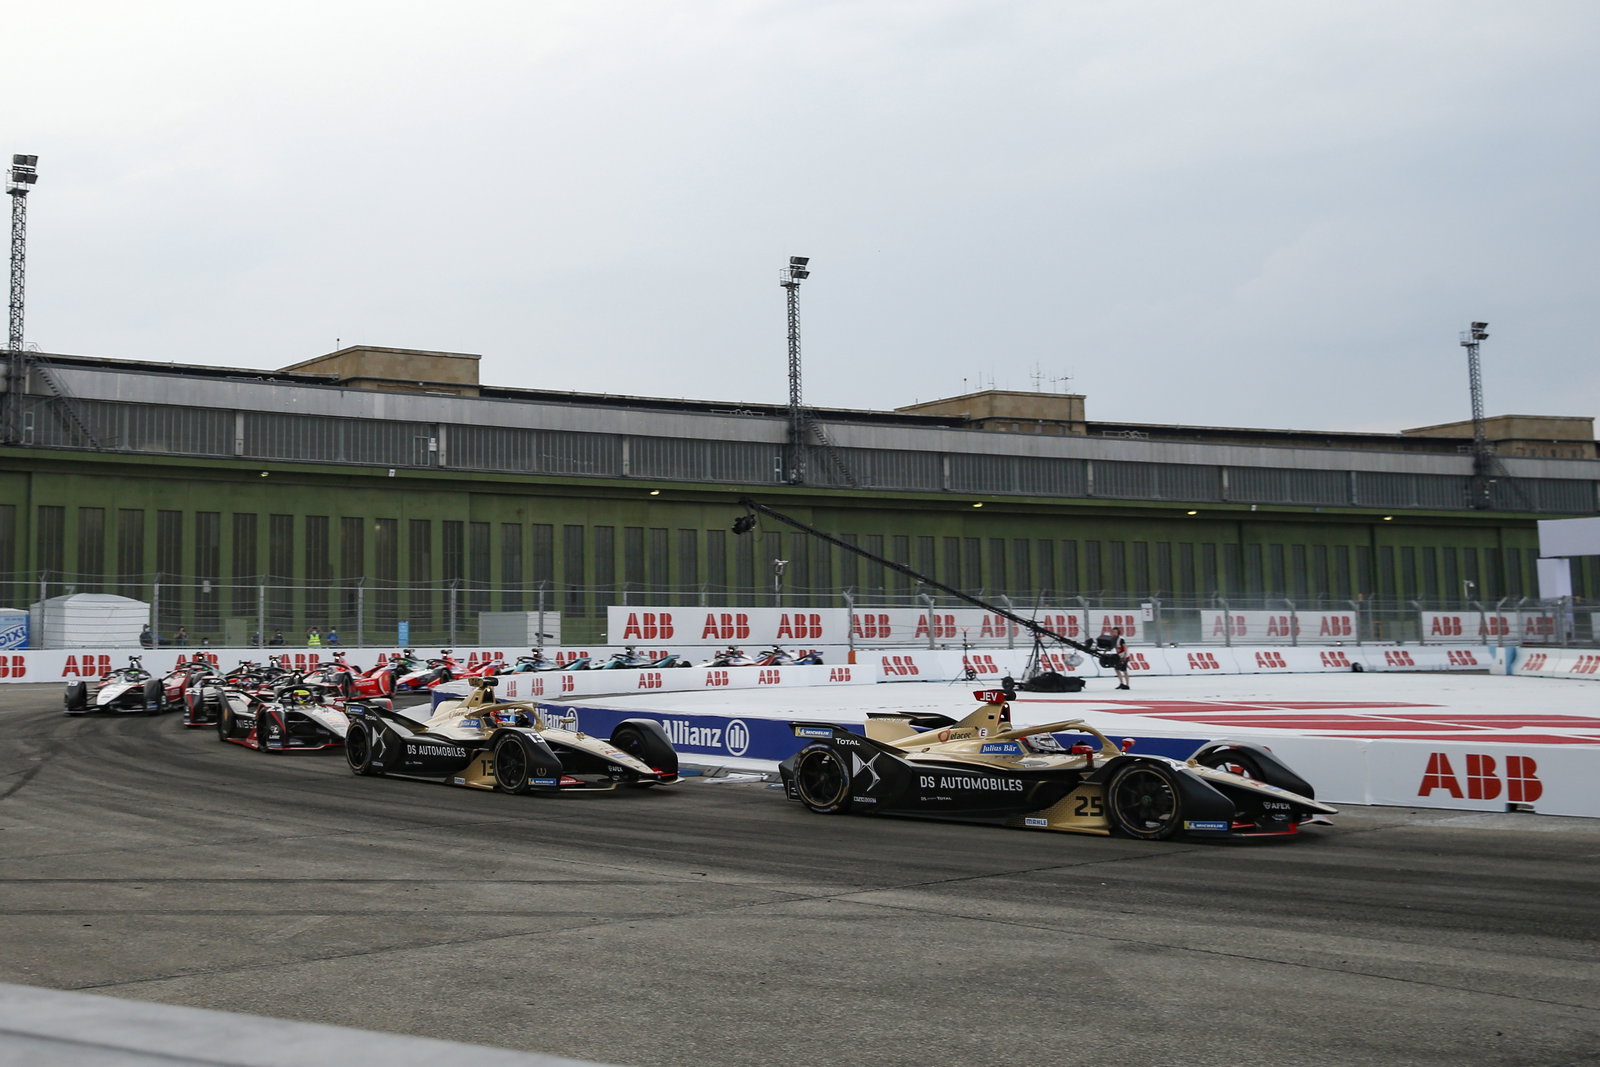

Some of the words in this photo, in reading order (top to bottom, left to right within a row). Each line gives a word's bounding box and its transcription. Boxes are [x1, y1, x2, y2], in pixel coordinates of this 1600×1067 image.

[623, 613, 674, 640] ABB
[702, 613, 750, 639] ABB
[777, 614, 822, 638] ABB
[848, 614, 891, 638] ABB
[914, 614, 956, 638] ABB
[1039, 615, 1079, 638] ABB
[1101, 616, 1136, 637] ABB
[1213, 616, 1247, 636] ABB
[1320, 616, 1352, 636] ABB
[1431, 616, 1462, 636] ABB
[1478, 617, 1510, 635] ABB
[62, 655, 112, 677] ABB
[280, 654, 320, 673] ABB
[882, 656, 919, 676] ABB
[962, 655, 998, 674] ABB
[1187, 652, 1220, 670] ABB
[1256, 652, 1286, 668] ABB
[1320, 651, 1350, 667] ABB
[1384, 651, 1414, 666] ABB
[1447, 650, 1478, 666] ABB
[1521, 654, 1548, 670] ABB
[1569, 655, 1600, 674] ABB
[638, 673, 662, 689] ABB
[706, 671, 729, 686] ABB
[758, 670, 780, 684] ABB
[830, 668, 852, 682] ABB
[506, 680, 517, 697] ABB
[532, 678, 544, 696] ABB
[980, 692, 998, 701] JEV
[525, 732, 546, 744] 13
[662, 720, 722, 748] Allianz
[836, 738, 860, 746] TOTAL
[950, 732, 972, 740] efacec
[407, 744, 416, 755] DS
[419, 745, 466, 758] AUTOMOBILES
[982, 744, 1002, 752] Julius
[481, 760, 494, 776] 13
[1418, 752, 1543, 802] ABB
[920, 776, 935, 788] DS
[940, 776, 1024, 792] AUTOMOBILES
[1074, 796, 1105, 817] 25
